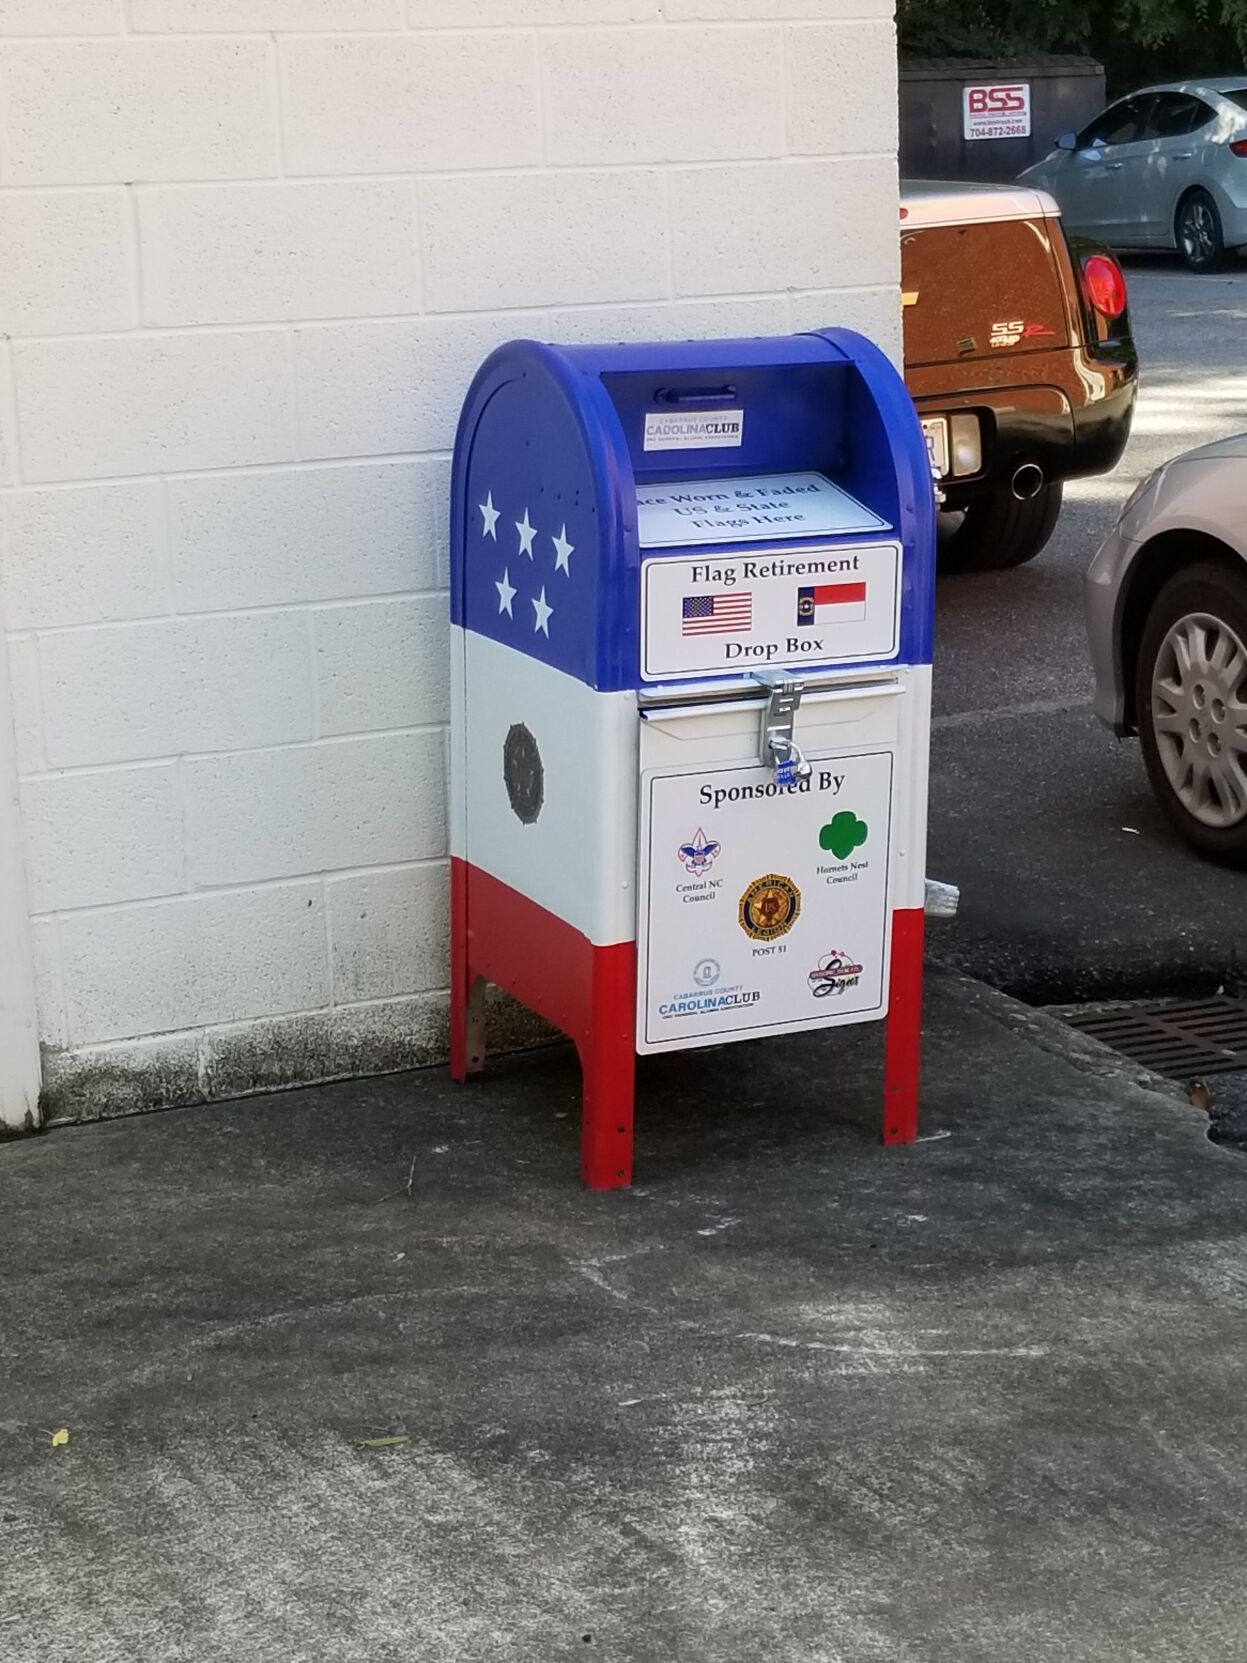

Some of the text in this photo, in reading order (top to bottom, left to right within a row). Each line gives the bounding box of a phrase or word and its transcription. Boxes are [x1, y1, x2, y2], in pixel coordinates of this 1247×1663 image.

[969, 87, 1025, 113] BSS
[669, 493, 730, 504] Worn
[734, 490, 754, 499] &
[756, 484, 821, 497] Faded
[673, 501, 791, 517] US & State
[691, 514, 807, 529] Flags Here
[691, 555, 860, 586] Flag Retirement
[725, 637, 825, 660] Drop Box
[699, 776, 811, 809] Sponsored
[819, 771, 846, 796] By
[816, 865, 849, 875] Hornets
[675, 878, 724, 893] Central NC
[826, 872, 858, 884] Council
[682, 891, 716, 903] Council
[752, 946, 776, 957] POST
